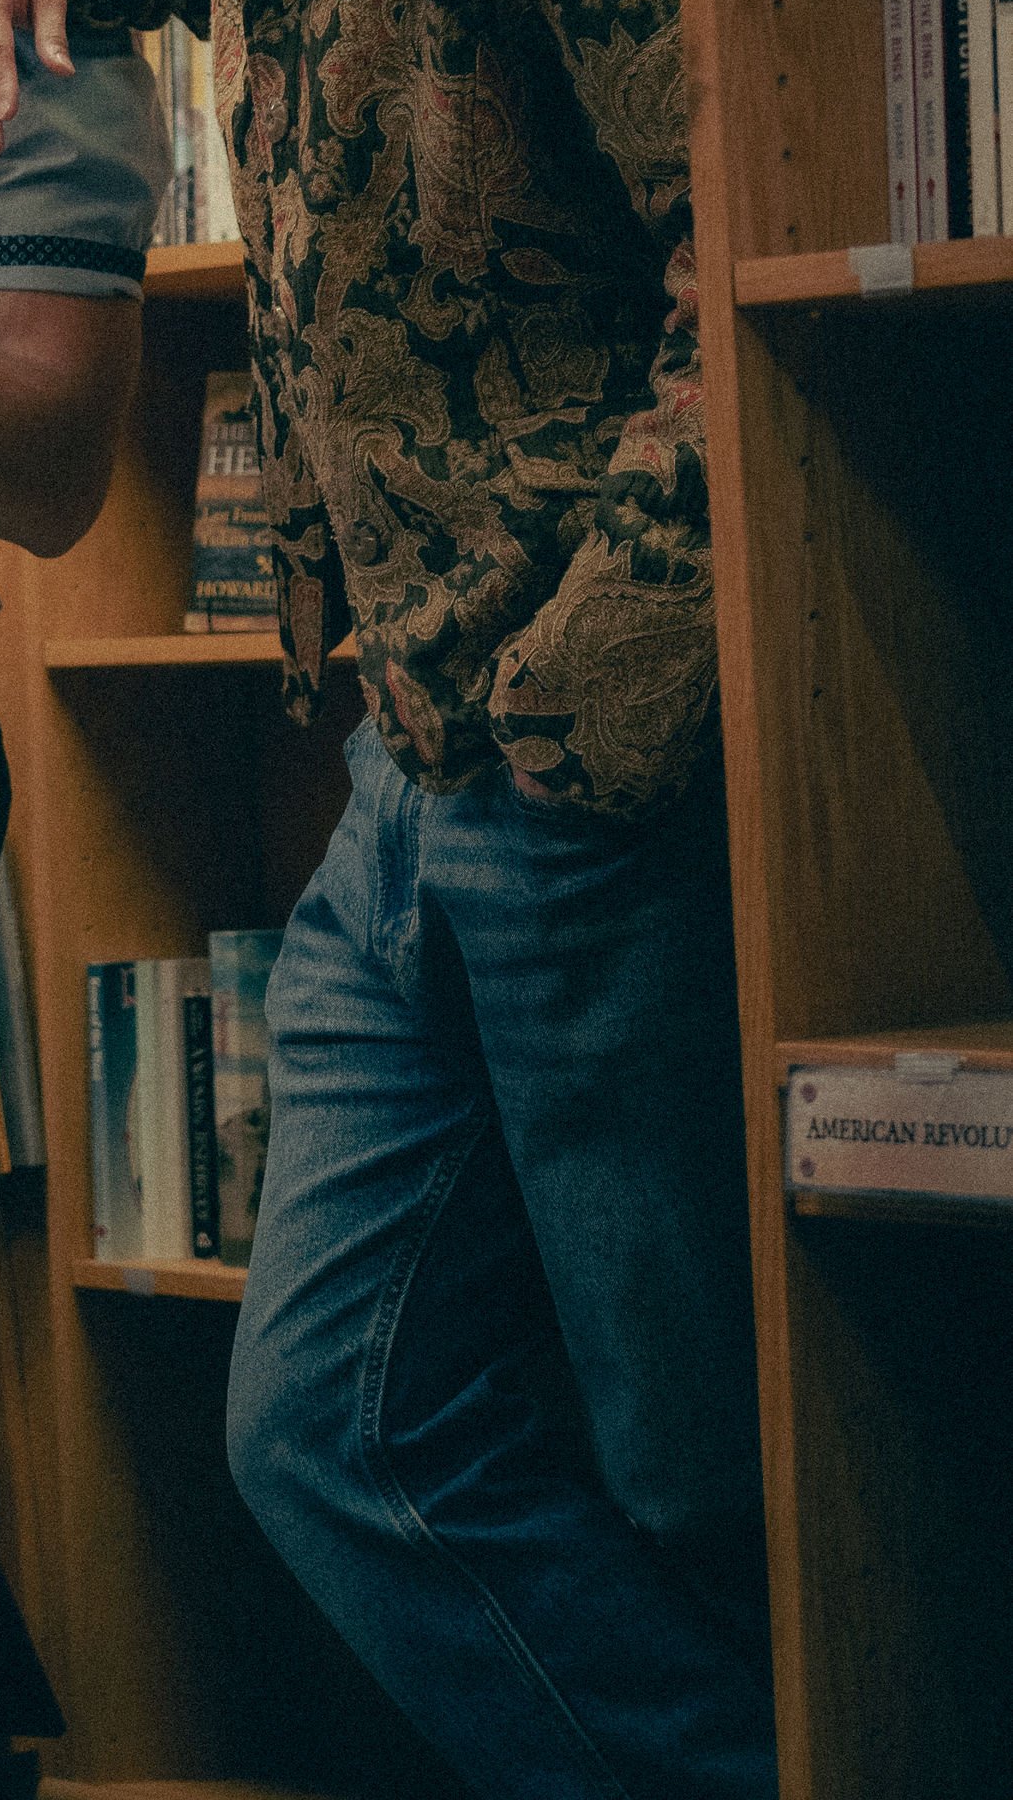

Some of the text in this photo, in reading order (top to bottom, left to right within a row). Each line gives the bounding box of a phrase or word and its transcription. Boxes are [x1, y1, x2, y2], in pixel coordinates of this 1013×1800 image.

[891, 37, 905, 82] RINGS
[921, 33, 934, 80] RINGS
[806, 1118, 917, 1144] AMERICAN
